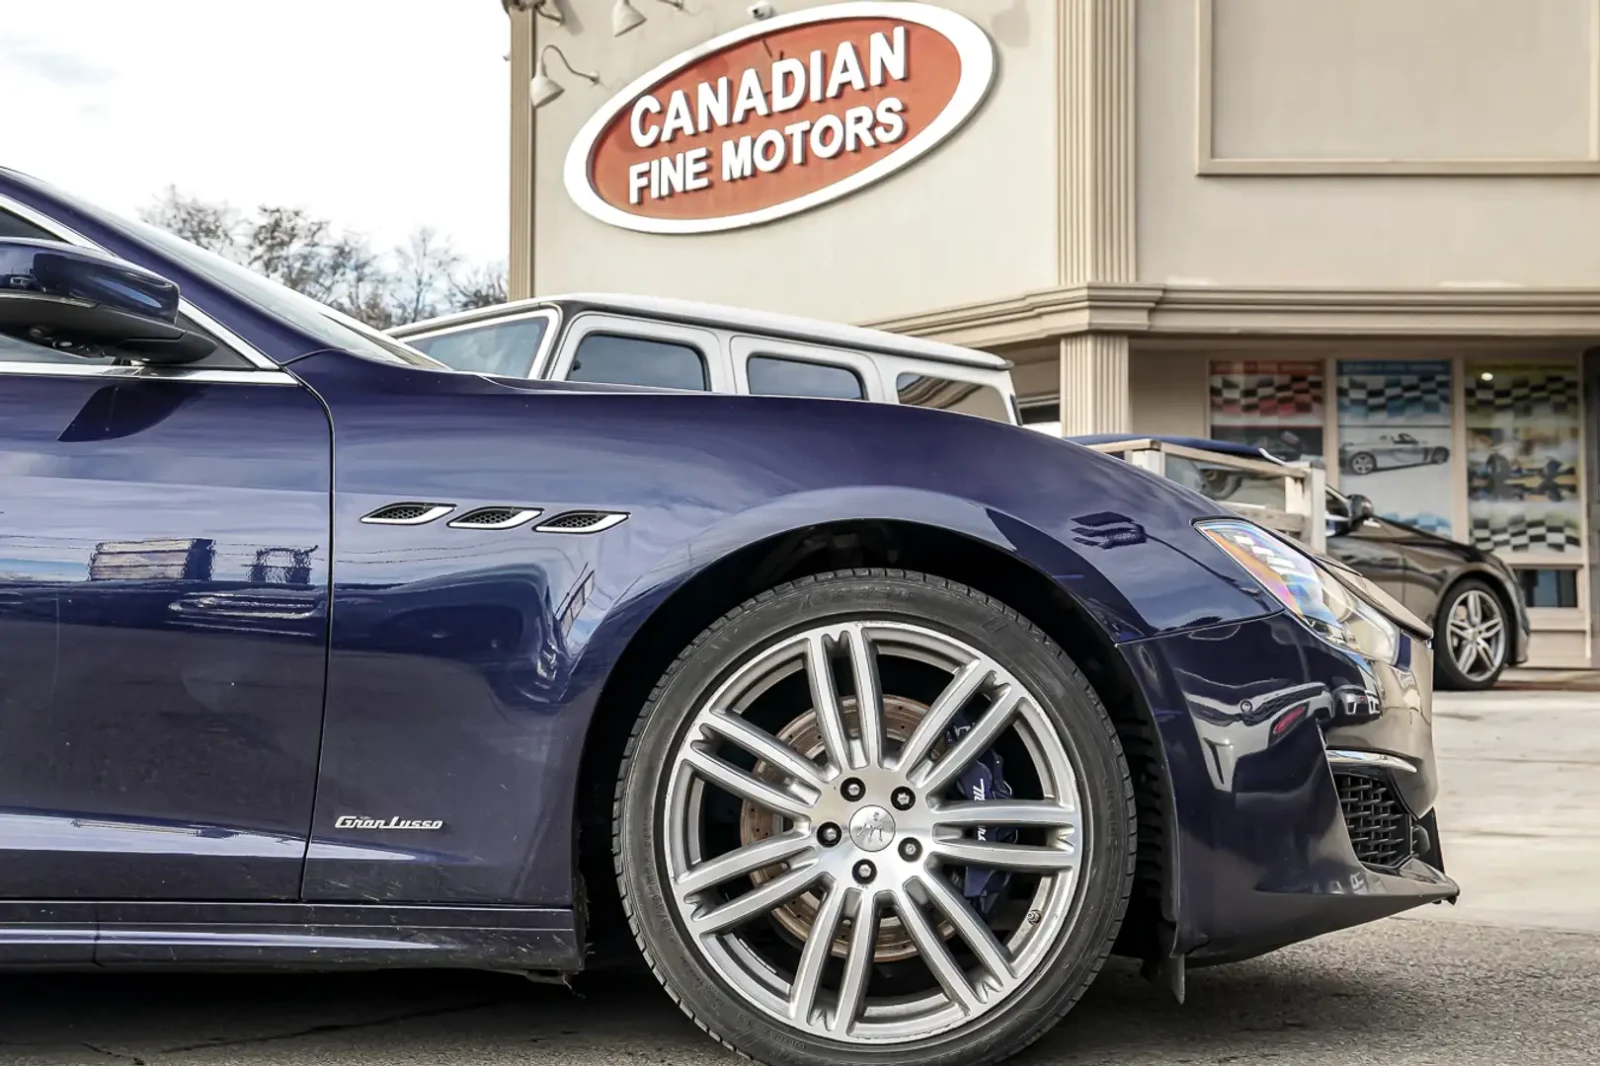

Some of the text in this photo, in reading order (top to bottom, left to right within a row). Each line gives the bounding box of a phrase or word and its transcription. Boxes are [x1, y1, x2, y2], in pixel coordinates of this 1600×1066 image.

[630, 26, 907, 148] CANADIAN
[628, 97, 906, 205] FINE MOTORS
